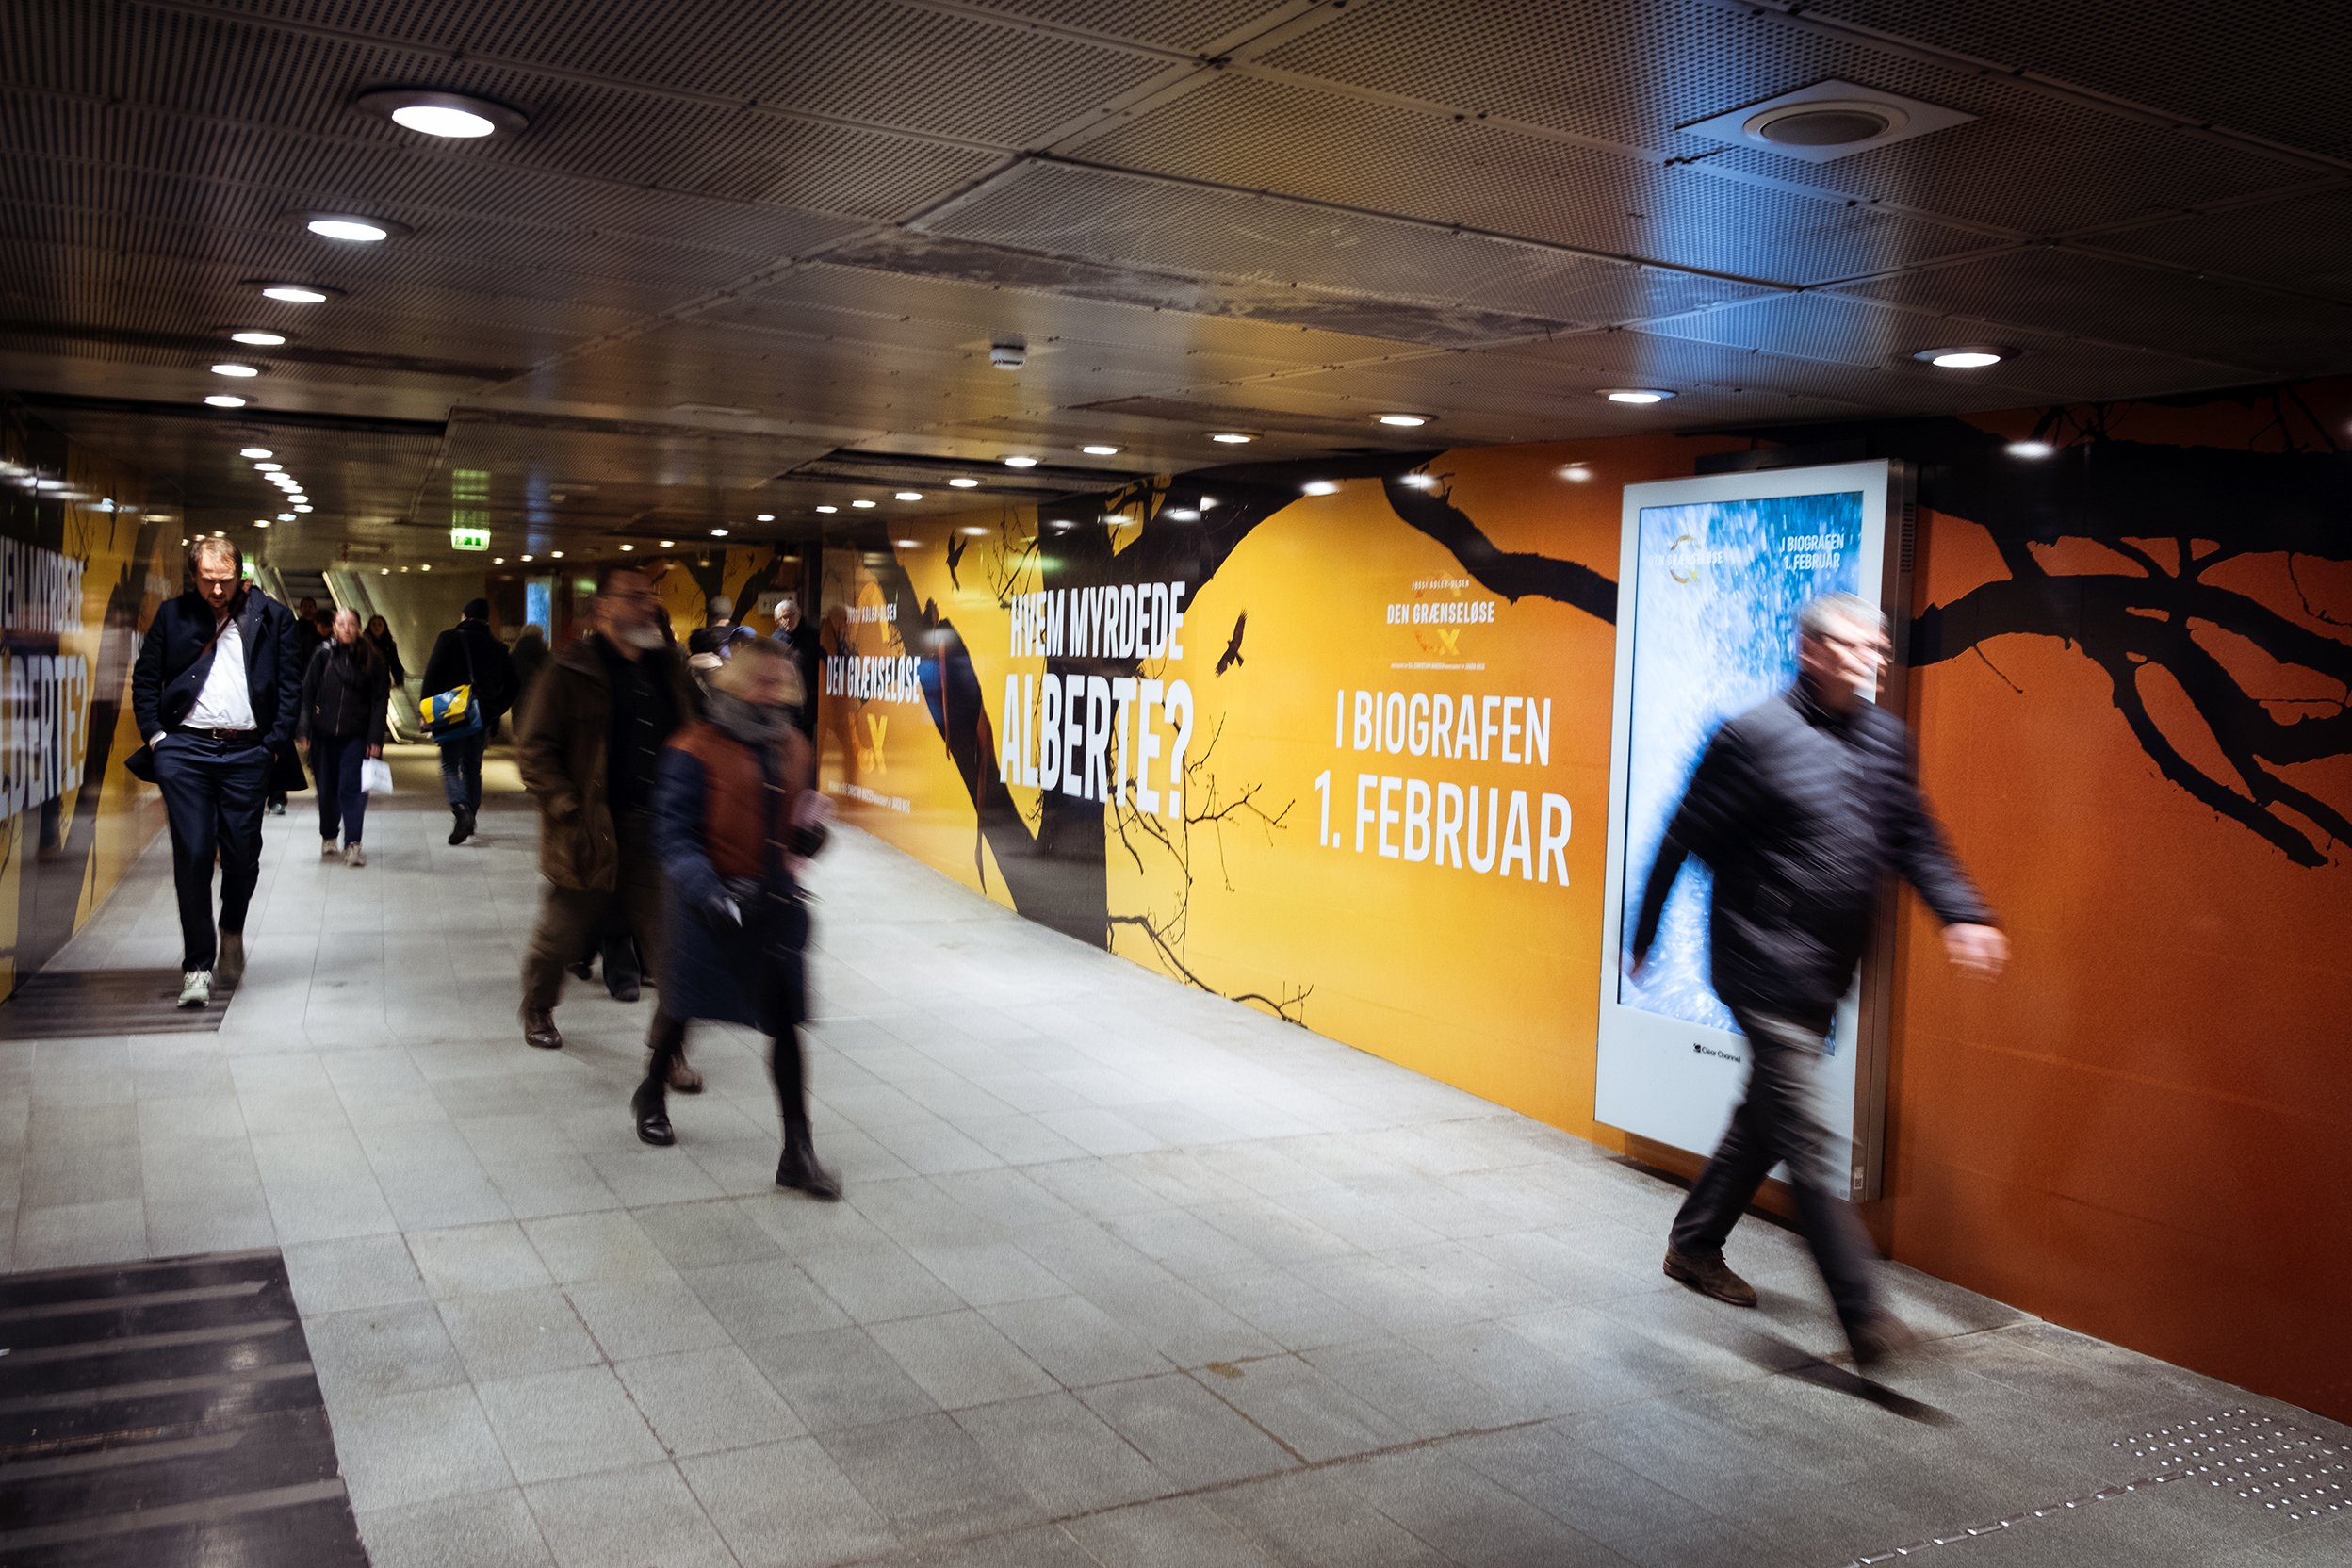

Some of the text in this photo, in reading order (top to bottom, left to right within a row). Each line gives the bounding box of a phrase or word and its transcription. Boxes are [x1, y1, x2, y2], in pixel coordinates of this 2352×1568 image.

[1783, 552, 1840, 571] 1. FEBRUAR
[1787, 533, 1845, 552] BIOGRAFEN
[1010, 580, 1186, 660] HVEM MYRDEDE
[1386, 600, 1495, 625] DEN GRÆNSELØSE
[825, 652, 921, 706] DEN GRÆNSELØSE
[0, 653, 88, 822] LBERTE?
[1000, 672, 1194, 820] ALBERTE?
[1335, 689, 1552, 767] I BIOGRAFEN
[1314, 769, 1573, 888] 1. FEBRUAR
[1702, 1046, 1741, 1063] Clear Channel
